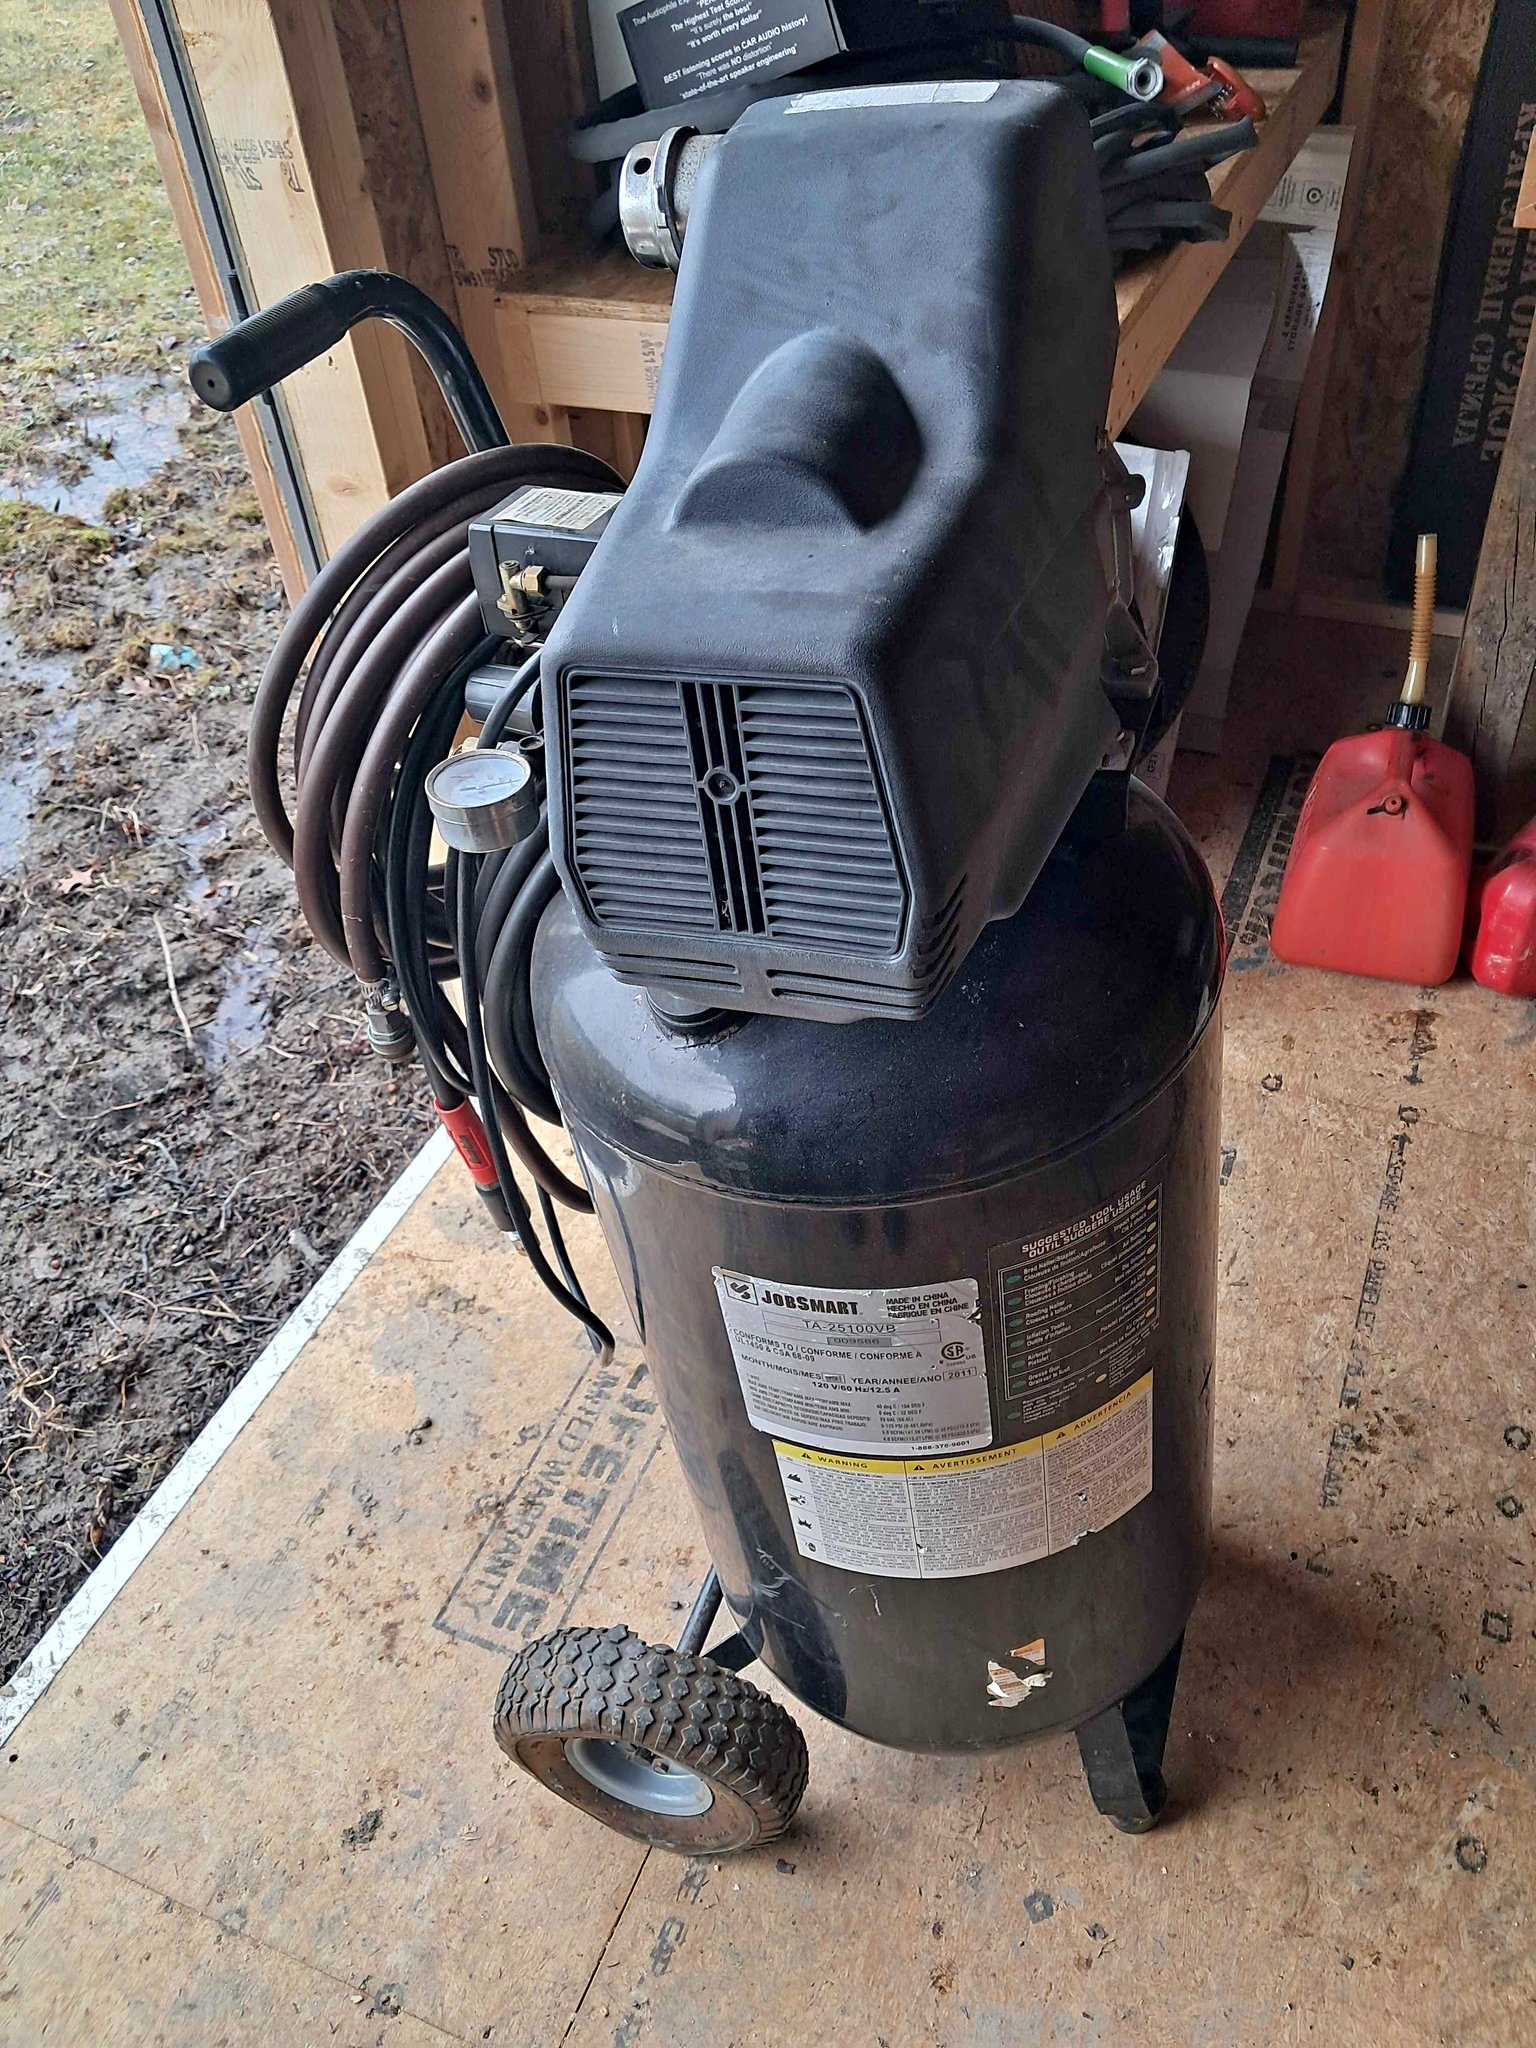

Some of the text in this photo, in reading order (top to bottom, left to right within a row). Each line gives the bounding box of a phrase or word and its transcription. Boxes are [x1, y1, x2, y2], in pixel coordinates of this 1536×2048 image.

[632, 15, 647, 26] True
[670, 22, 684, 33] The
[683, 9, 710, 26] Highest
[709, 3, 725, 15] Test
[703, 17, 722, 29] surely
[722, 11, 735, 22] the
[700, 29, 721, 43] worth
[720, 20, 740, 35] every
[663, 14, 809, 84] BEST listening scores in CAR AUDIO history!
[717, 61, 731, 72] was
[730, 55, 743, 67] NO
[728, 61, 756, 80] speaker
[1021, 1180, 1147, 1253] SUGGESTED TOOL USAGE
[1028, 1192, 1142, 1258] OUTIL SUGGERE USAGE
[1023, 1265, 1038, 1275] Brad
[1023, 1268, 1051, 1282] Cloueuse
[761, 1289, 859, 1316] JOBSMART
[886, 1296, 910, 1306] MADE
[923, 1291, 949, 1302] CHINA
[886, 1297, 958, 1312] HECHO EN CHINA
[888, 1302, 970, 1320] FABRIQUE EN CHINE
[1025, 1307, 1049, 1319] Roofing
[803, 1319, 896, 1337] TA-25100VB
[1026, 1321, 1066, 1340] Inflation Tools
[733, 1327, 781, 1349] CONFORMS
[782, 1341, 794, 1351] TO
[800, 1346, 853, 1360] CONFORME
[859, 1351, 914, 1361] CONFORME
[915, 1351, 923, 1359] A
[734, 1335, 764, 1352] UL1450
[765, 1345, 773, 1353] &
[773, 1346, 791, 1358] CSA
[1027, 1347, 1052, 1361] Airbrush
[741, 1353, 822, 1380] MONTH/MOIS/MES
[851, 1375, 941, 1386] YEAR/ANNEE/ANO
[948, 1369, 972, 1380] 2011
[1028, 1365, 1061, 1381] Grease Gun
[811, 1381, 829, 1390] 120
[830, 1384, 853, 1393] V/60
[855, 1385, 891, 1394] Hz/12.5
[1073, 1391, 1133, 1431] ADVERTENCIA
[817, 1455, 869, 1469] WARNING
[932, 1448, 1018, 1470] AVERTISSEMENT
